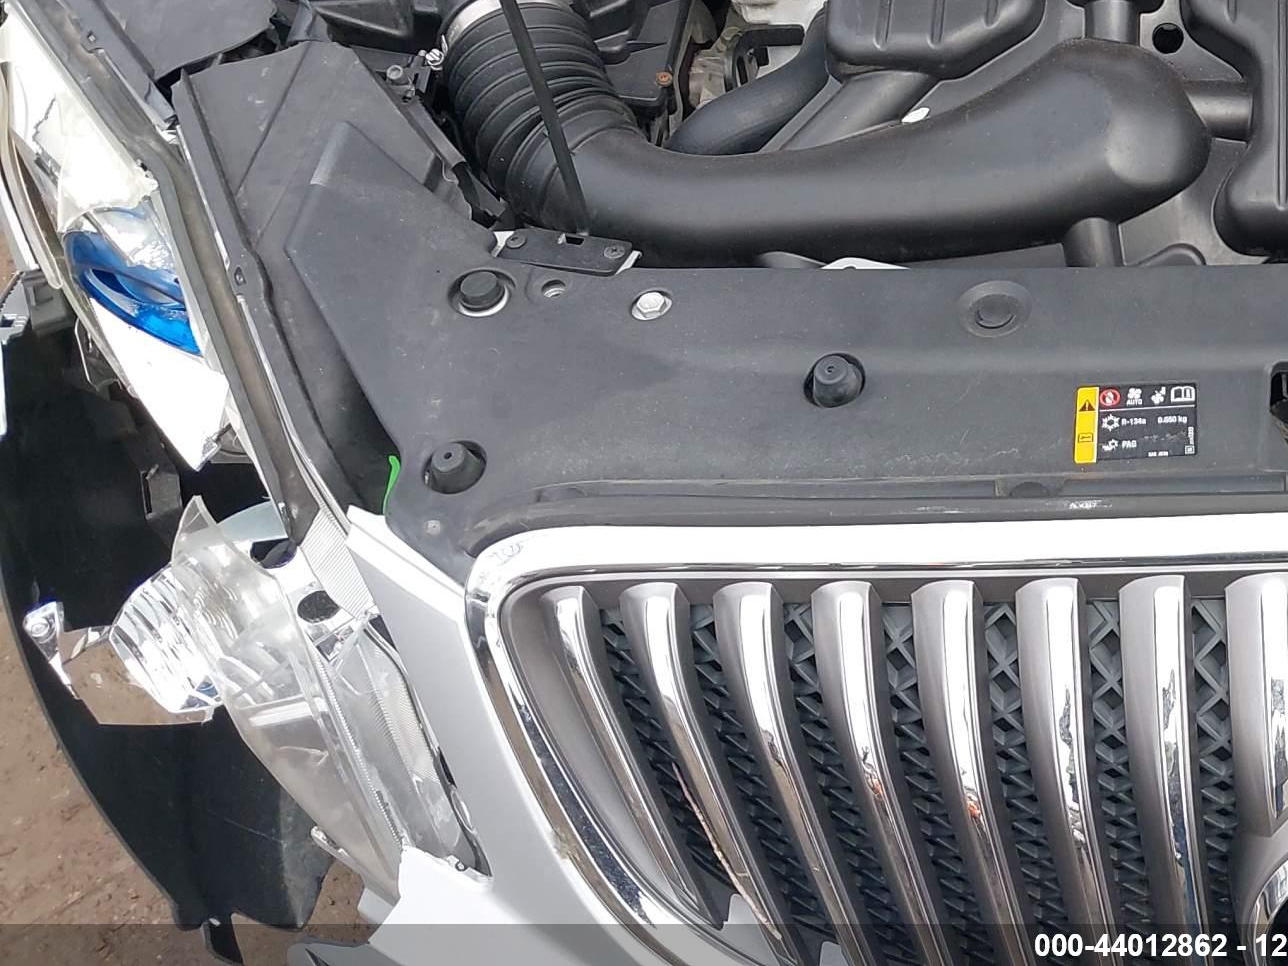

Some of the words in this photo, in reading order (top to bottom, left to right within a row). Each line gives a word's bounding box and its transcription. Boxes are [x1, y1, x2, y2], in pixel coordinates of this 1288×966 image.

[1126, 398, 1143, 406] AUTO
[1121, 417, 1147, 426] R-134a
[1178, 415, 1188, 424] kg
